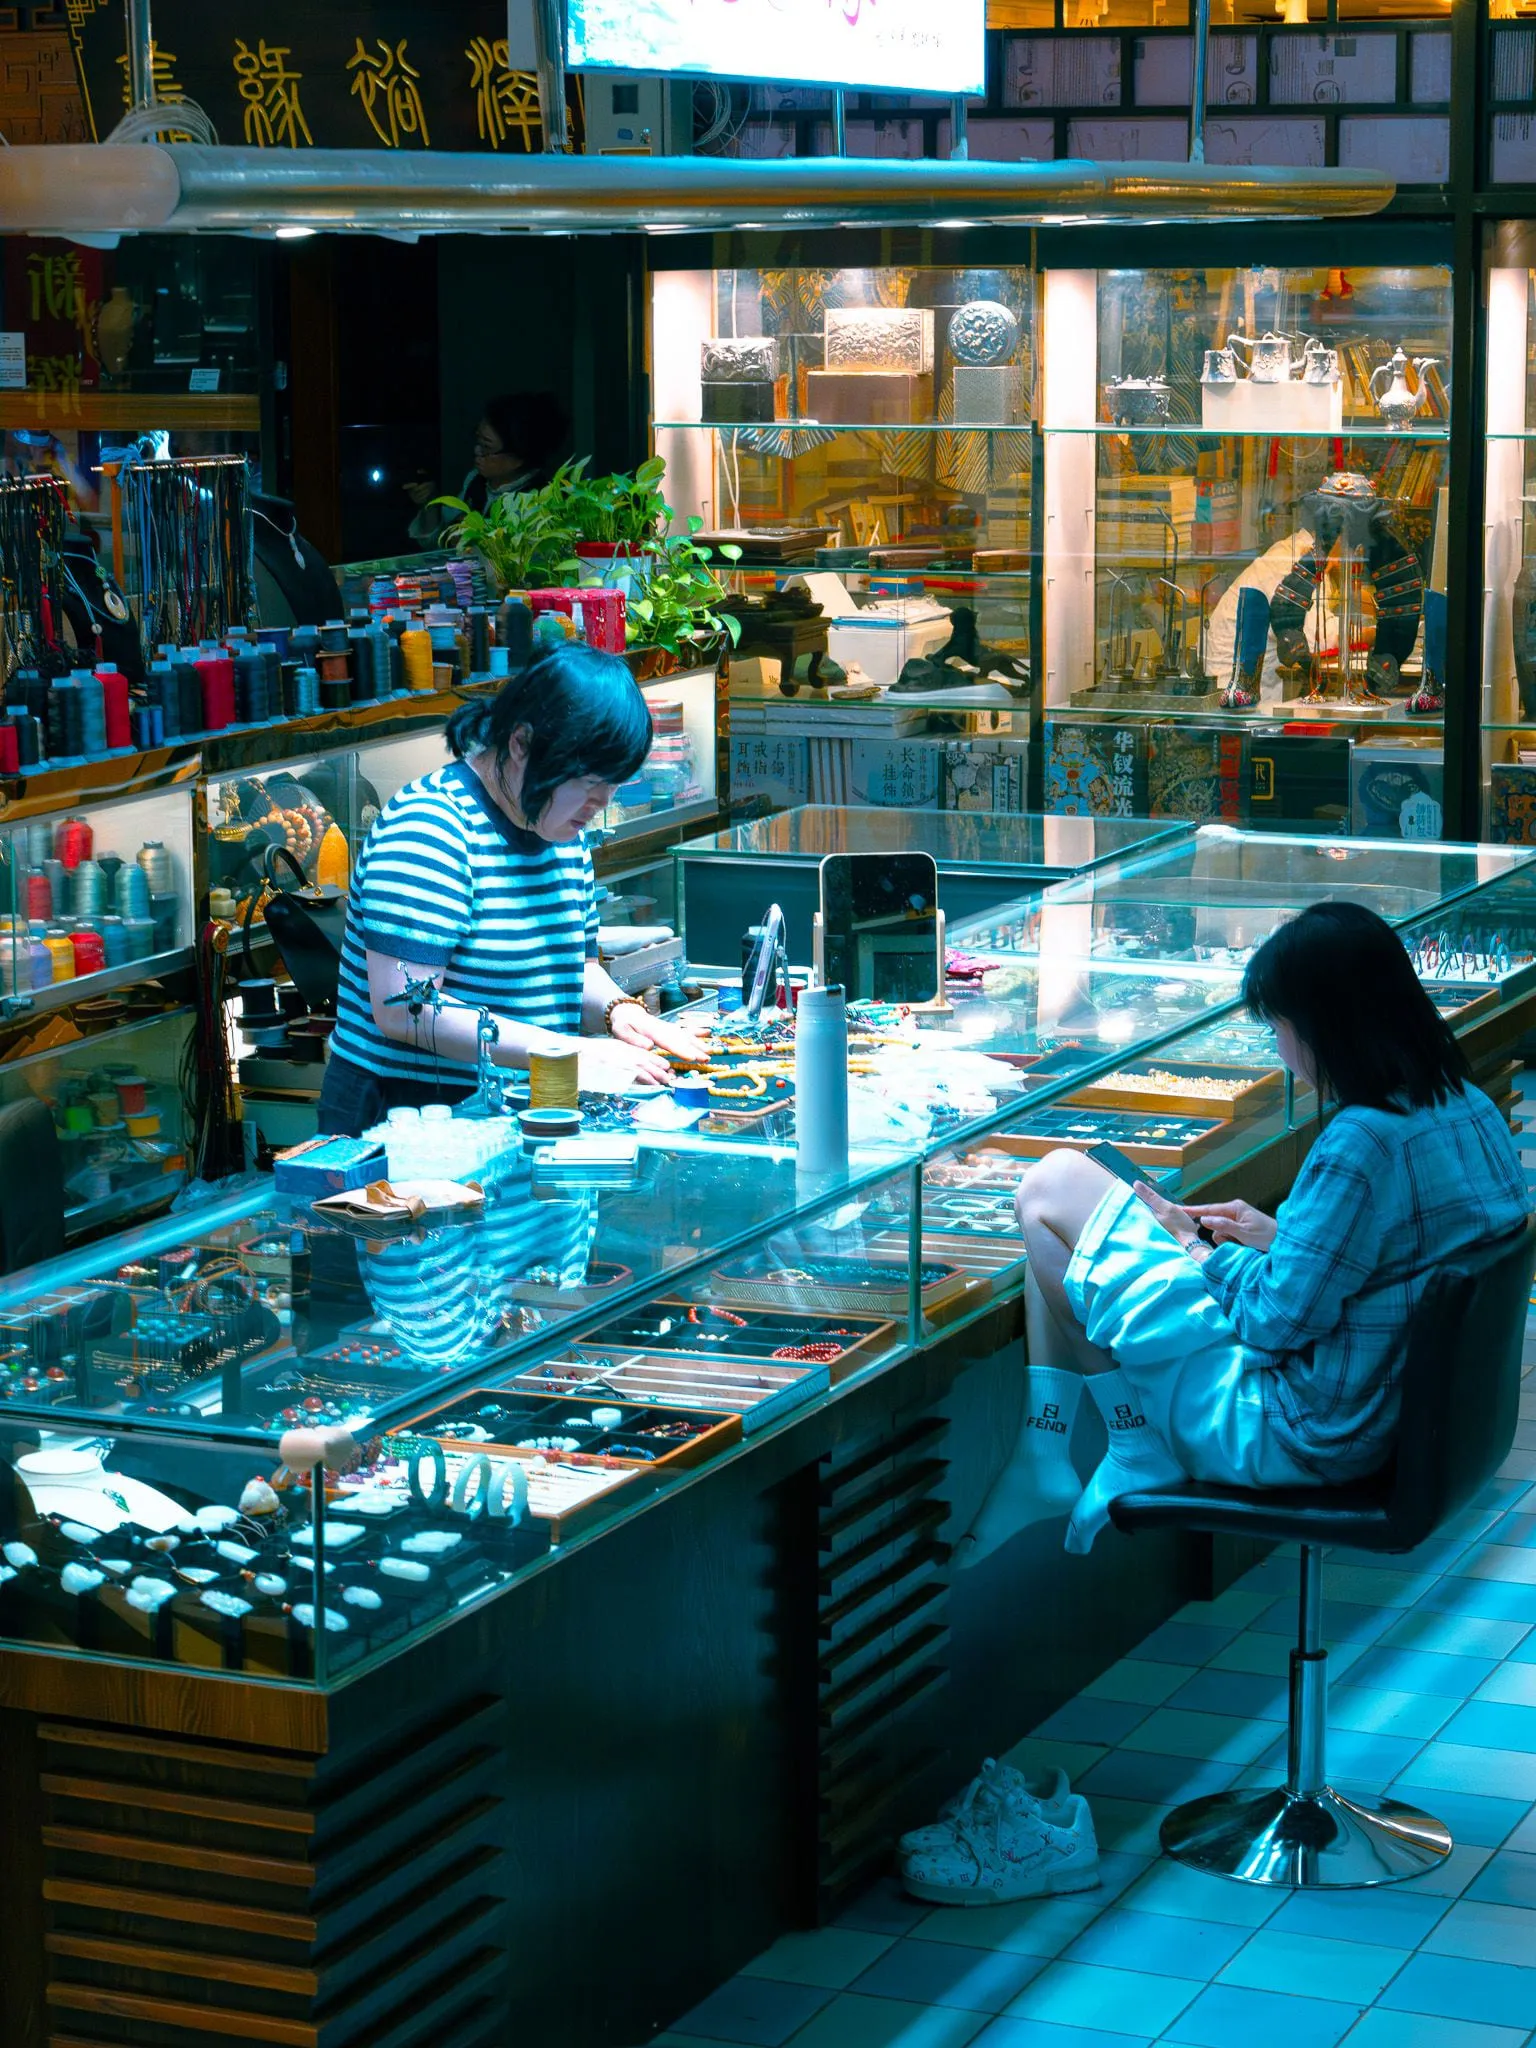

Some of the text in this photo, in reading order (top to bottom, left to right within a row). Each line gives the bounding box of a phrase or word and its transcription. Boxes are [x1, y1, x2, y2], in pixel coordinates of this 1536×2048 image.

[900, 746, 916, 799] 长命锁
[1112, 731, 1134, 817] 华钗流光
[1026, 1416, 1067, 1435] FENDI
